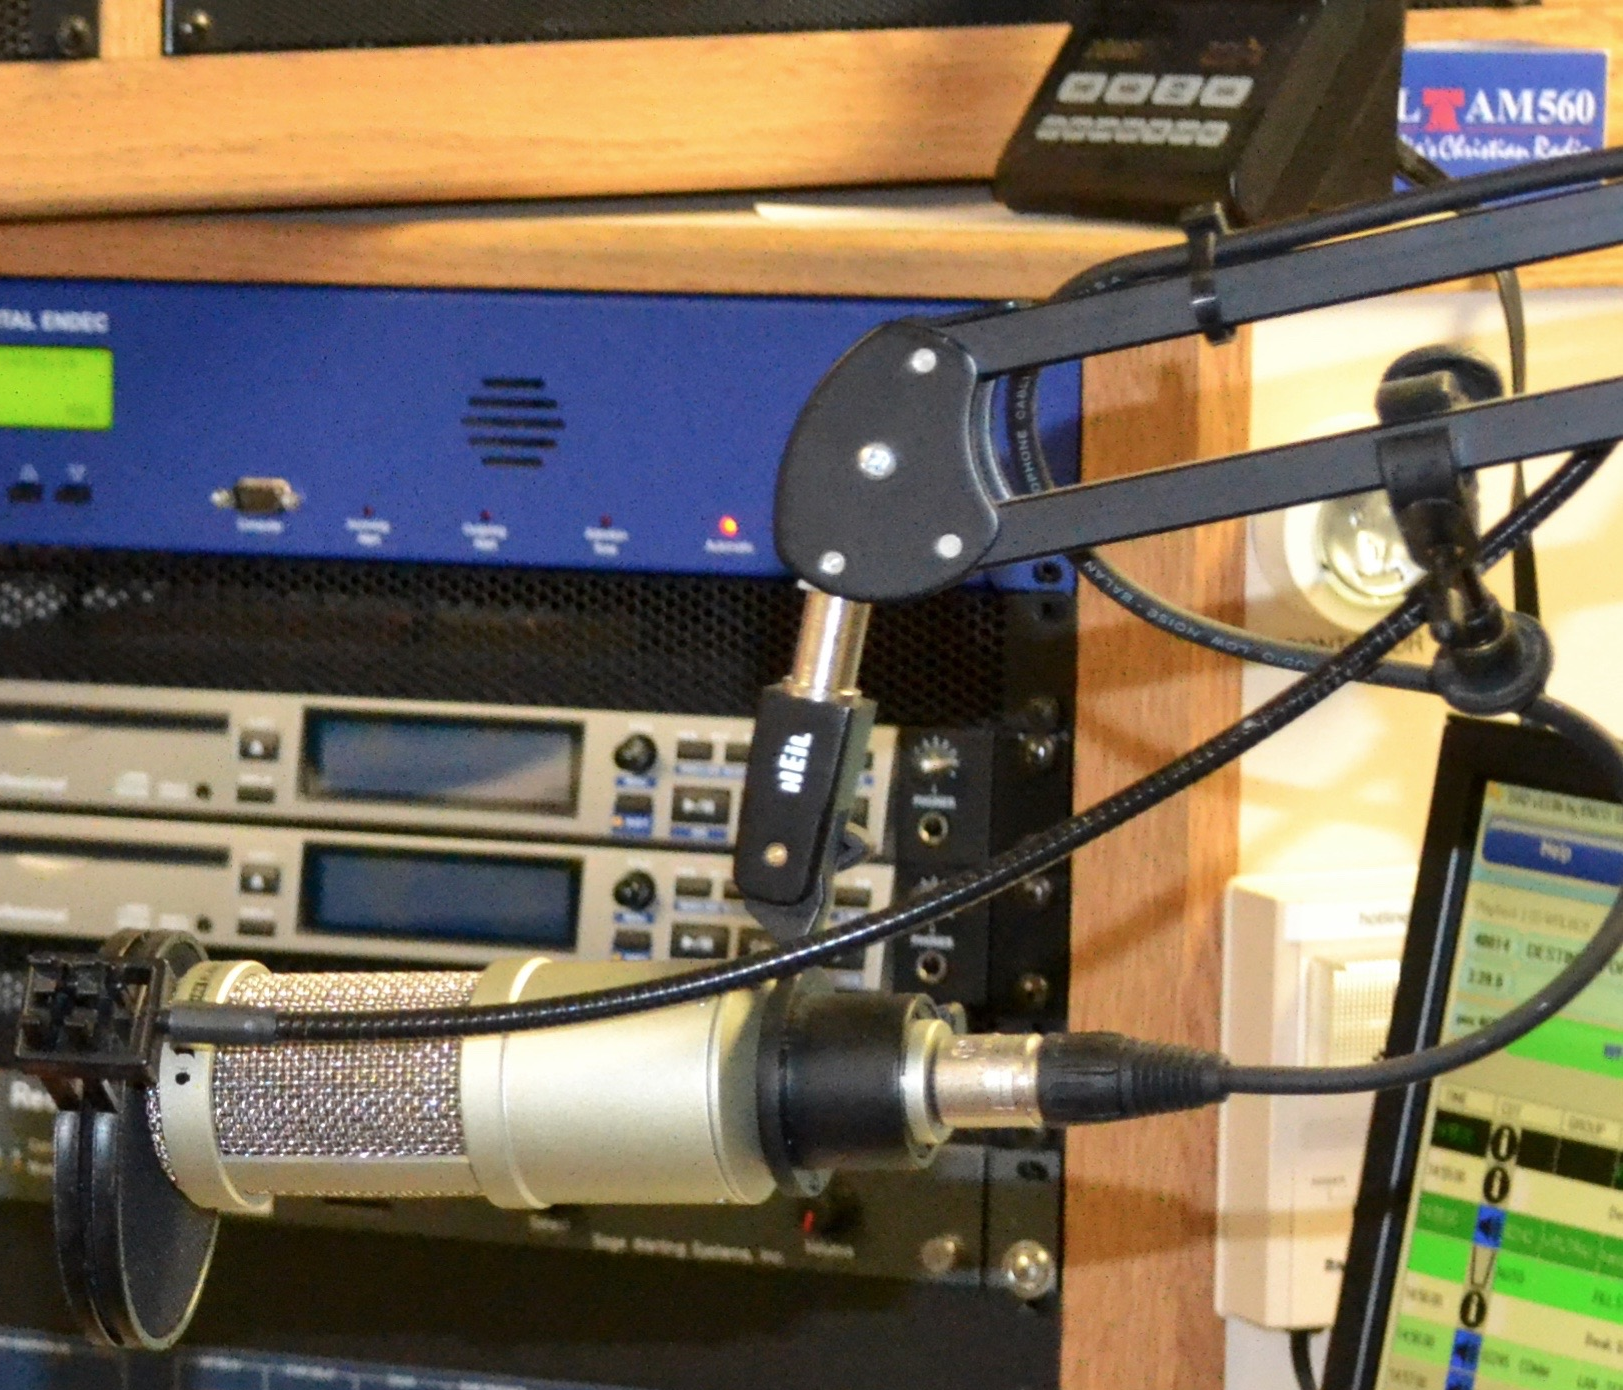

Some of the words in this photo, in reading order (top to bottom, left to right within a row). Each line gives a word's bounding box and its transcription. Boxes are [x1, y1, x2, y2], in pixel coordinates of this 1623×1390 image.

[1465, 87, 1596, 125] AM560
[1438, 133, 1530, 161] Christian
[39, 309, 110, 334] ENDEC
